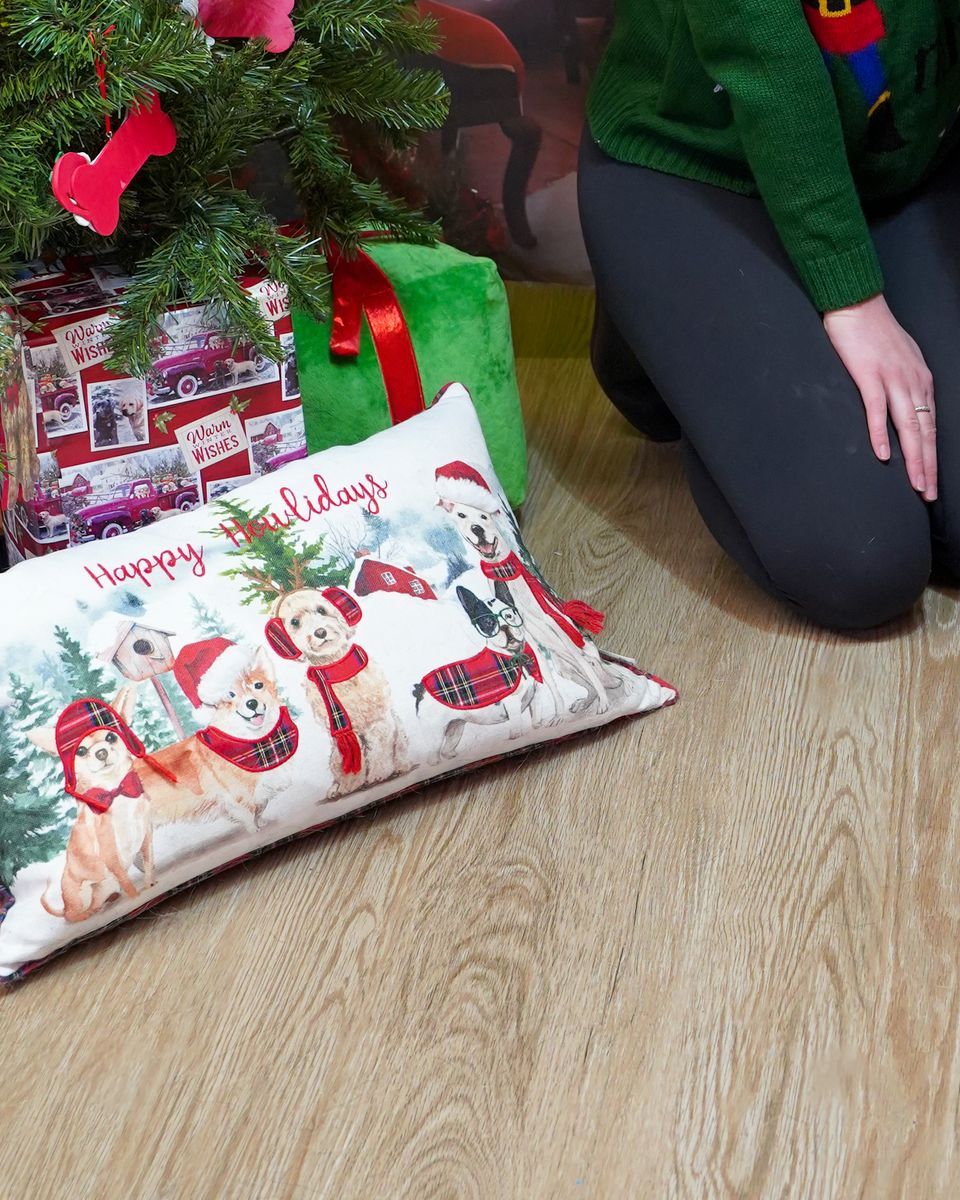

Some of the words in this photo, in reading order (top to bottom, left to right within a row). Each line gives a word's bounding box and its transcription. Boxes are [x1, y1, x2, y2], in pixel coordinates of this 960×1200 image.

[70, 341, 111, 366] WISH
[186, 420, 232, 444] Warm
[192, 429, 232, 449] WINTER
[191, 435, 239, 465] WISHES
[84, 543, 206, 588] Happy
[218, 474, 388, 548] Howlidays
